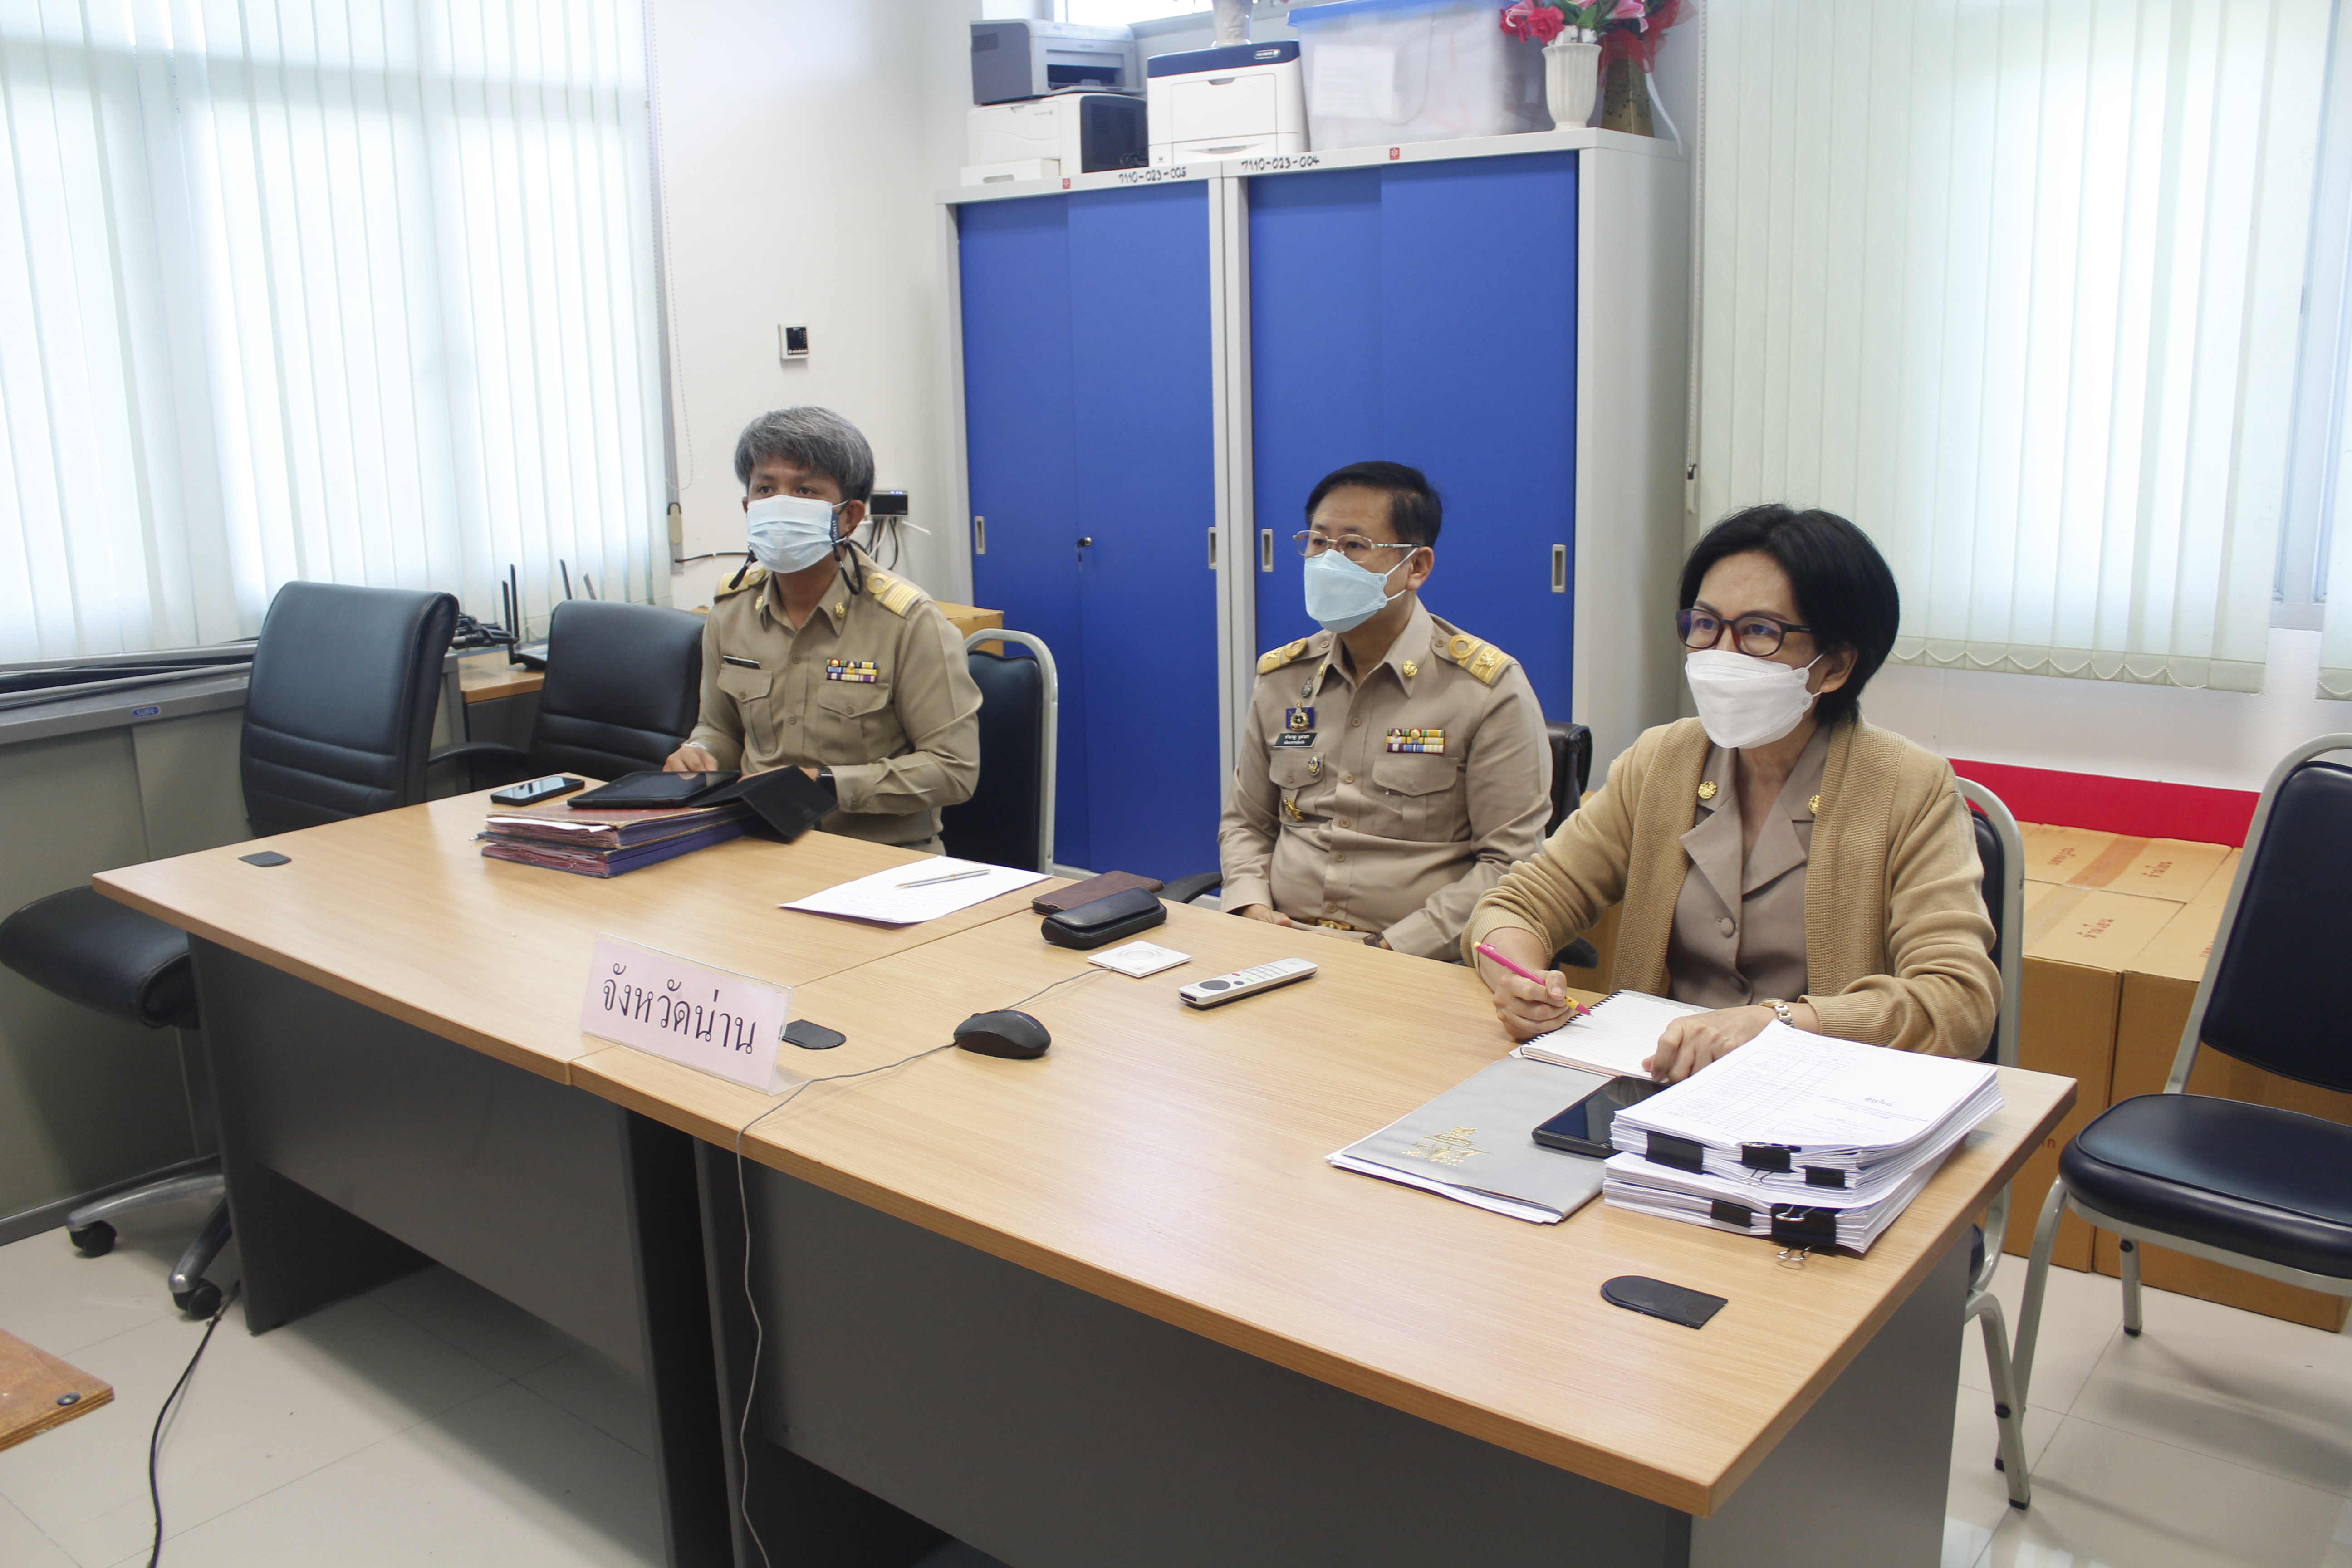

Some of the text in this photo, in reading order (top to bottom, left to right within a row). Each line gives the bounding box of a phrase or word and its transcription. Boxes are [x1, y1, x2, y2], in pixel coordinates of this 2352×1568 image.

[1241, 155, 1320, 171] 7110-023-004
[1118, 166, 1186, 183] 7110-023-005
[603, 963, 756, 1054] จังหวัดน่าน
